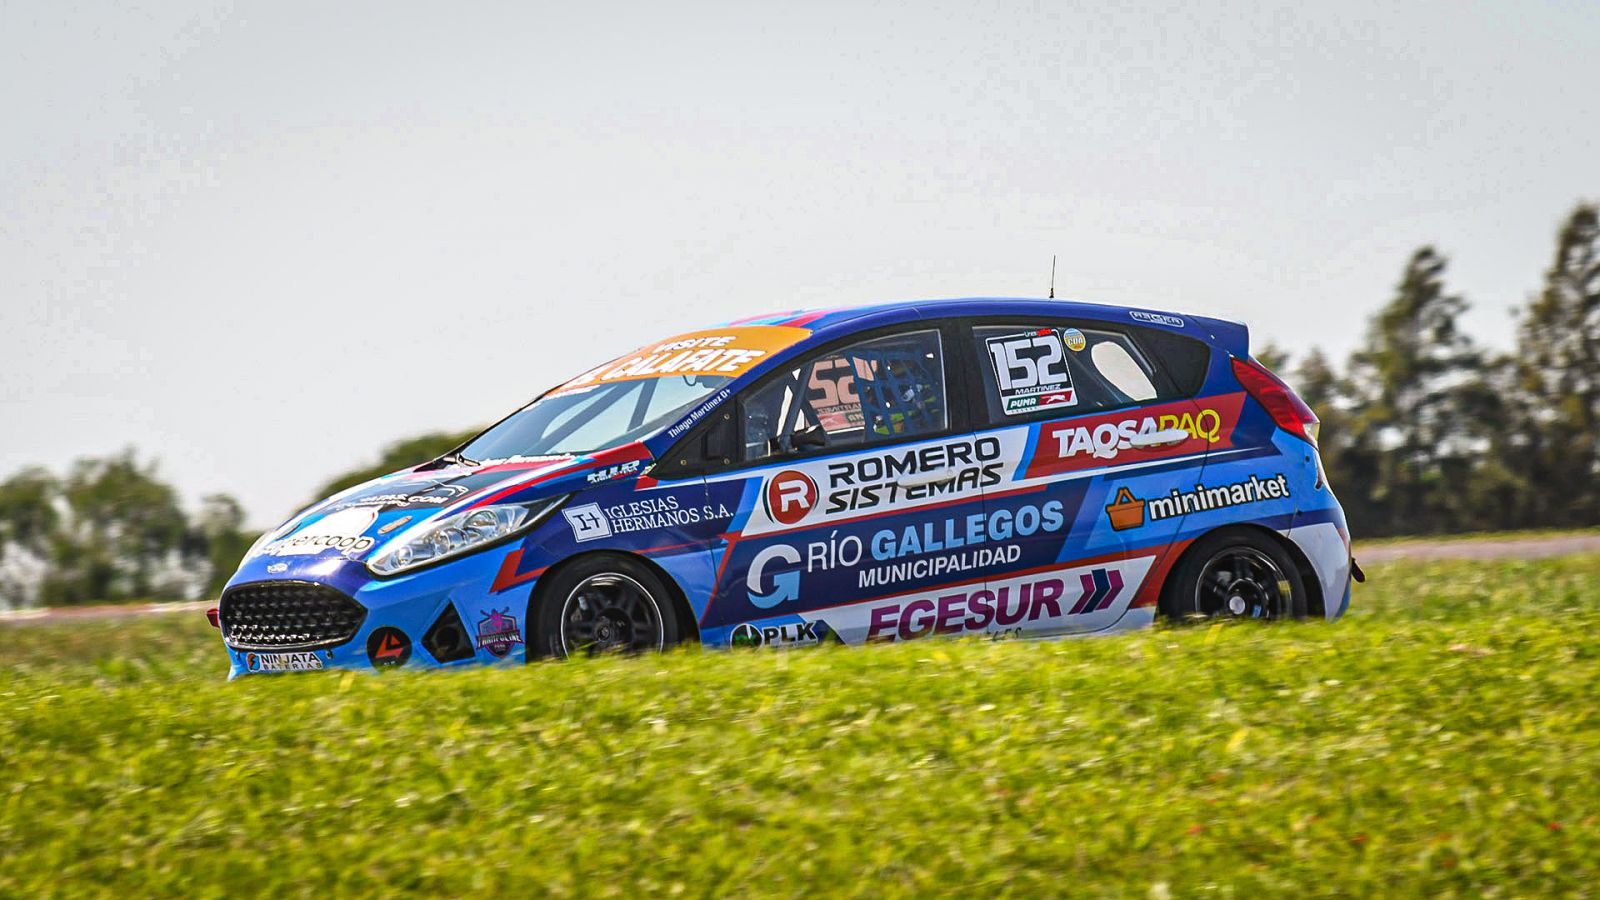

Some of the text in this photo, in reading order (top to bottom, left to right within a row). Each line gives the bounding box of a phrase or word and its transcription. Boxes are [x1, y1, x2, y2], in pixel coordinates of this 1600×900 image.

[990, 335, 1067, 390] 152
[1010, 397, 1037, 409] PUMA
[1015, 384, 1061, 395] MARTINEZ
[668, 419, 693, 438] Thiago
[690, 396, 724, 421] Martinez
[828, 437, 1001, 489] ROMERO
[604, 495, 679, 519] IGLESIAS
[825, 463, 1004, 514] SISTEMAS
[1150, 474, 1290, 520] minimarket
[610, 503, 734, 534] HERMANOS S.A.
[807, 500, 1065, 573] RÍO GALLEGOS
[858, 544, 1021, 589] MUNICIPALIDAD
[865, 578, 1065, 643] EGESUR
[763, 622, 817, 645] PLK
